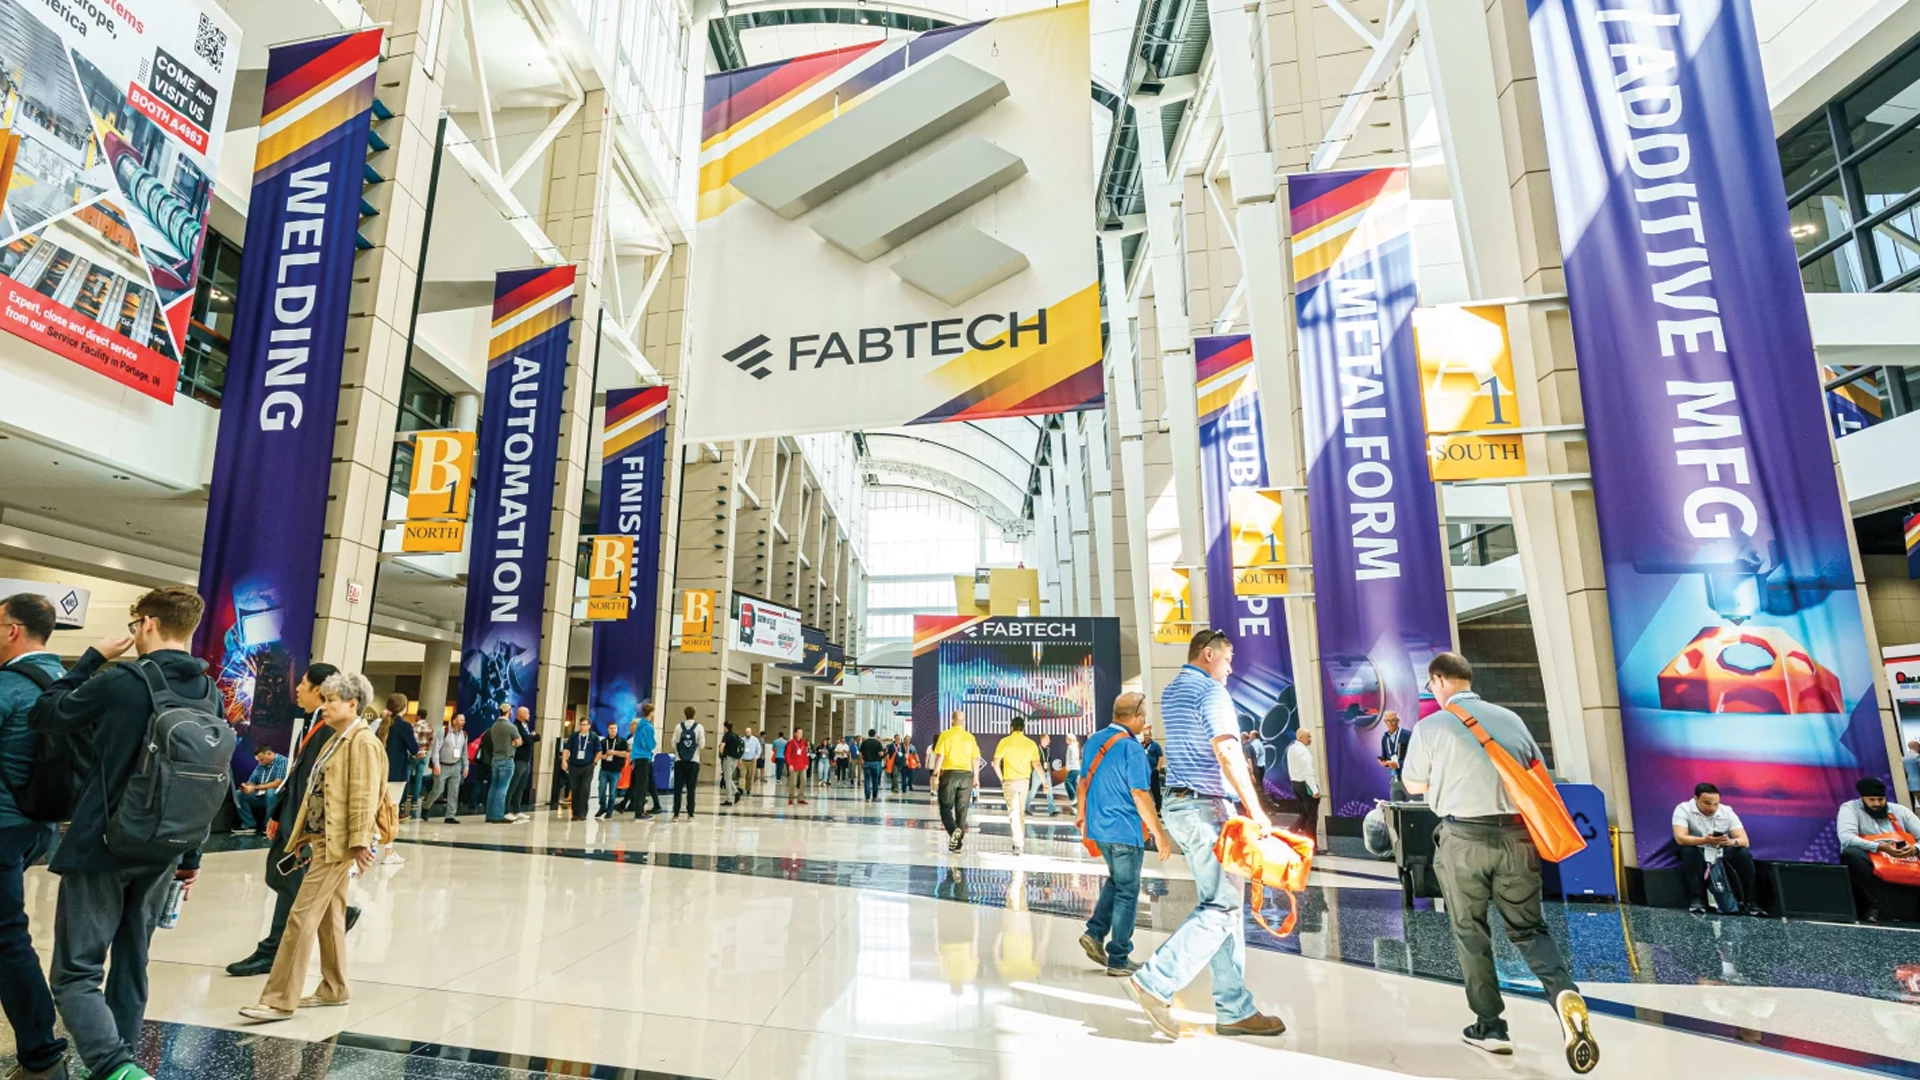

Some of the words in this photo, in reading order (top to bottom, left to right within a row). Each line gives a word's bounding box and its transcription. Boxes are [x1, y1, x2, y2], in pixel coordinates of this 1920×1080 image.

[154, 74, 188, 109] VISIT
[188, 100, 205, 122] US
[156, 55, 196, 93] COME
[195, 88, 213, 106] AND
[131, 90, 170, 123] BOOTH
[259, 161, 332, 432] WELDING
[5, 305, 29, 326] from
[29, 320, 46, 334] our
[47, 325, 80, 350] Service
[80, 341, 111, 366] Facility
[110, 356, 119, 367] in
[119, 360, 150, 384] Portage,
[151, 375, 161, 387] IN
[8, 290, 42, 318] Expert,
[43, 309, 68, 329] close
[68, 321, 86, 337] and
[85, 329, 110, 347] direct
[110, 340, 138, 362] service
[788, 308, 1048, 372] FABTECH
[1226, 411, 1261, 486] TUB
[1335, 278, 1401, 582] METALFORM
[1435, 442, 1520, 462] SOUTH
[1666, 380, 1758, 539] MFG
[490, 355, 541, 623] AUTOMATION
[405, 526, 459, 539] NORTH
[1236, 572, 1285, 585] SOUTH
[588, 601, 626, 611] NORTH
[982, 622, 1076, 637] FABTECH
[682, 639, 711, 647] NORTH
